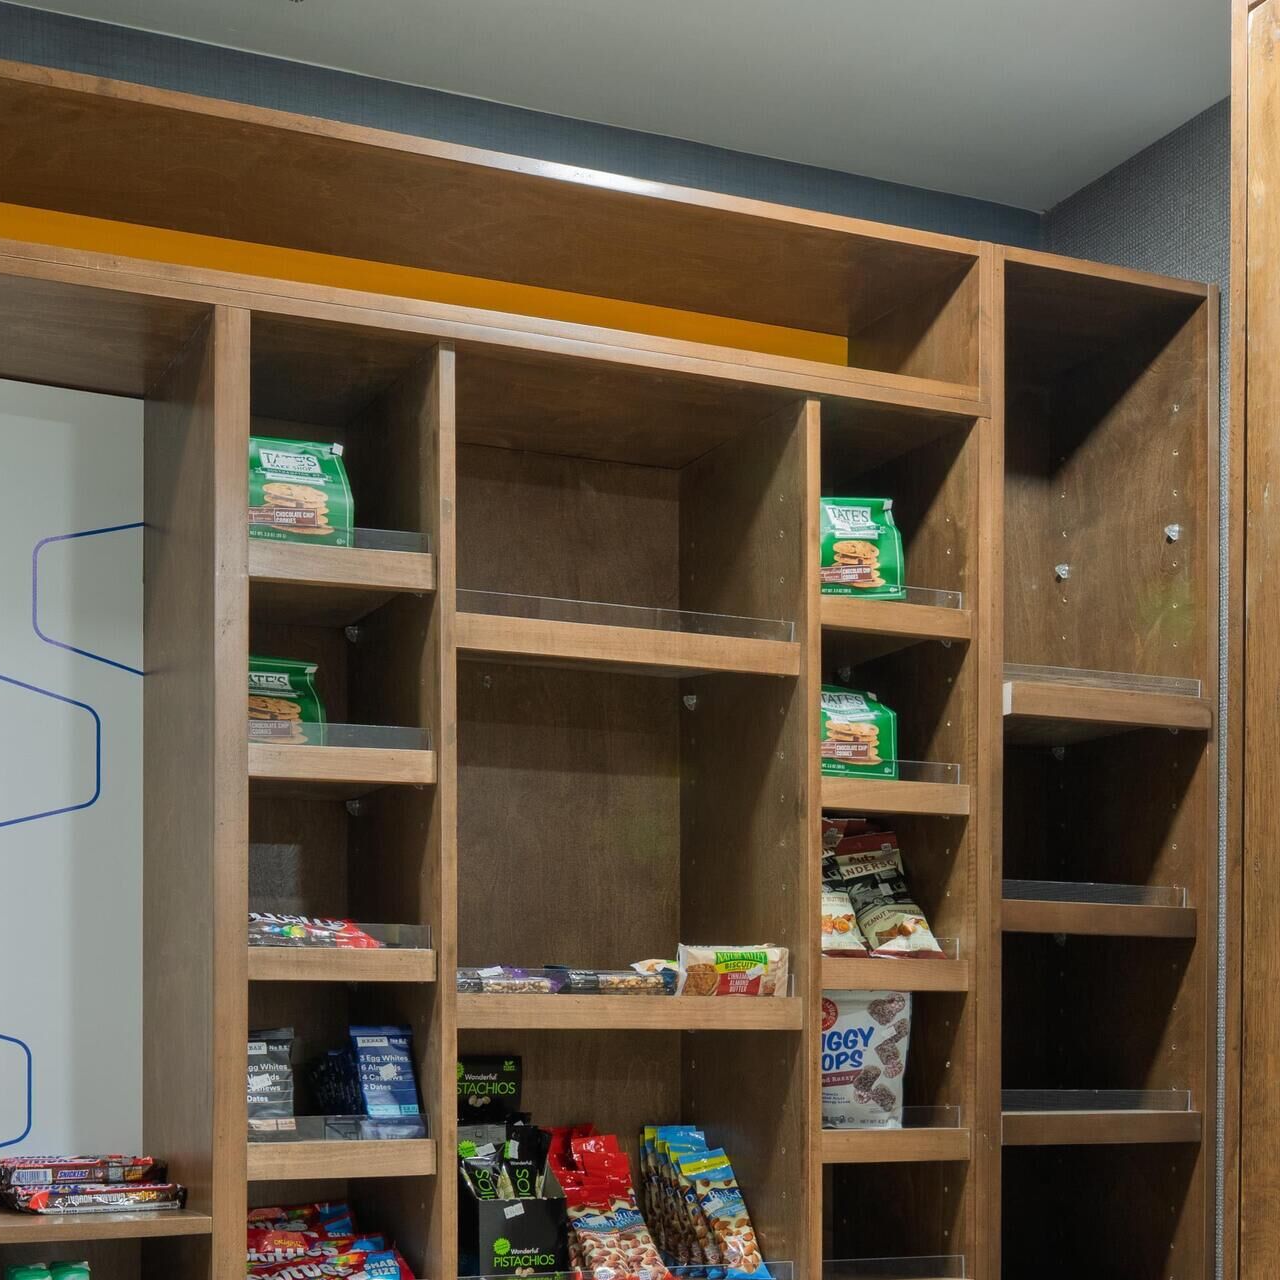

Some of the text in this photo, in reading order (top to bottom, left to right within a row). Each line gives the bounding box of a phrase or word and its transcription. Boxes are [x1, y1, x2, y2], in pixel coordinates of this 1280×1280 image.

[829, 507, 869, 522] TATE'S
[366, 1054, 409, 1063] Egg Whites
[258, 1063, 288, 1071] Whites
[464, 1072, 498, 1081] Wonderful
[370, 1083, 392, 1091] Dates
[58, 1170, 89, 1179] SNICKERS
[511, 1247, 540, 1256] Wonderful
[493, 1254, 555, 1268] PISTACHIOS
[371, 1266, 397, 1276] SIZE
